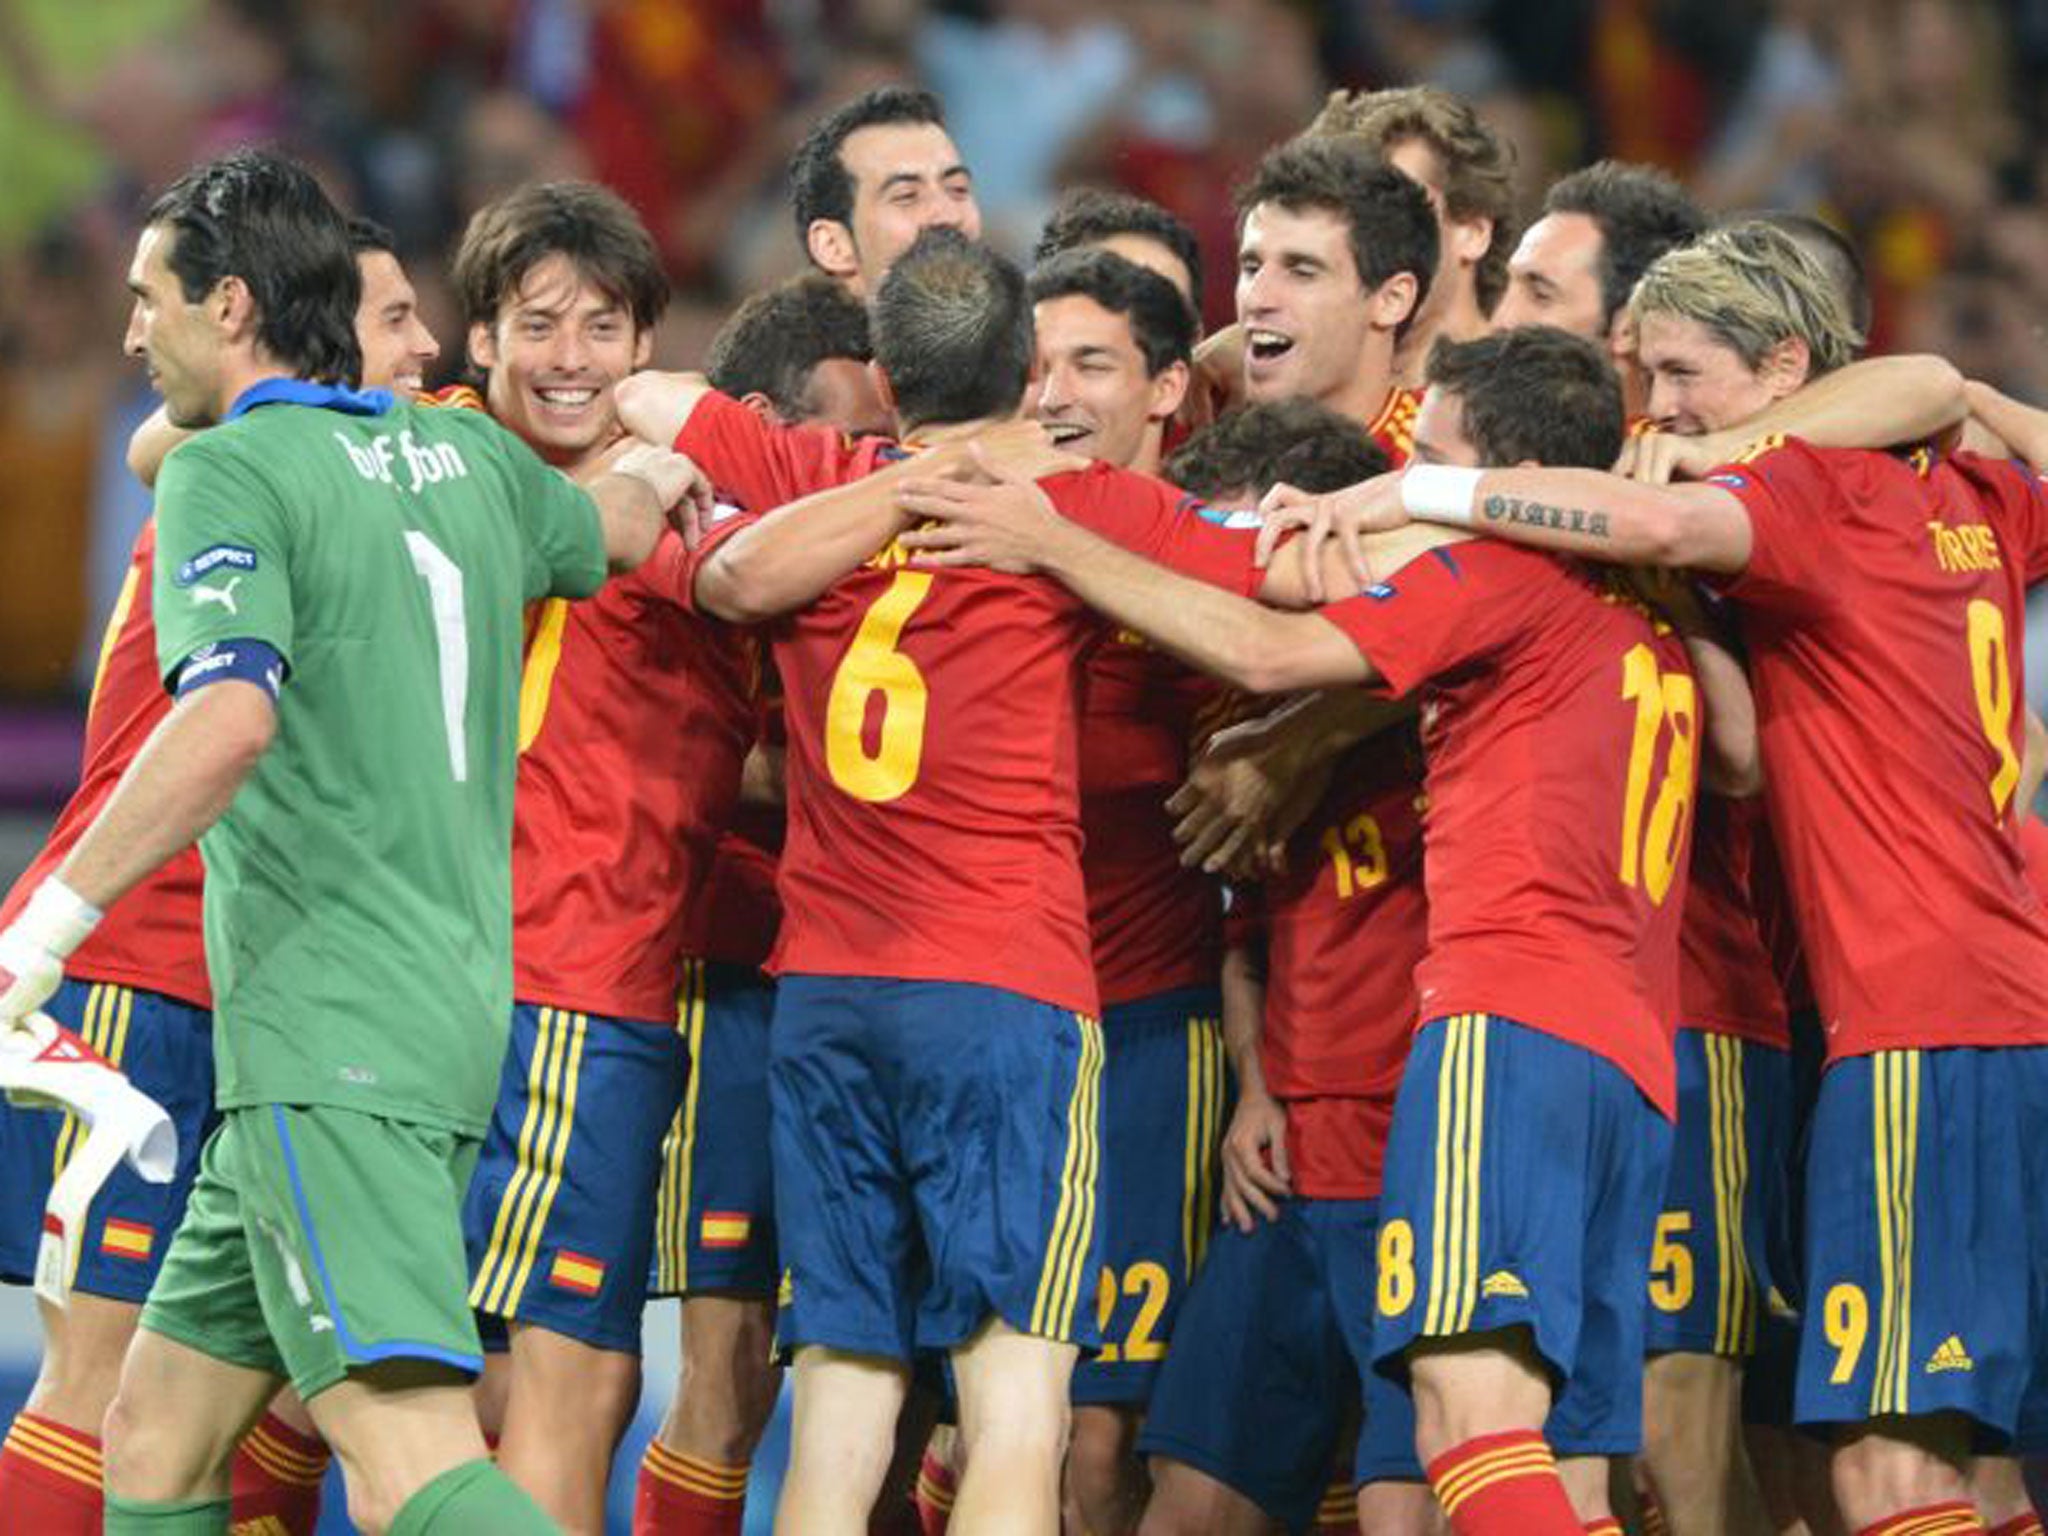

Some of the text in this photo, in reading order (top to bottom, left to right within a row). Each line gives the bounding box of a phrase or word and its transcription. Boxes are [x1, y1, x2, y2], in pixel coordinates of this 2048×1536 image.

[403, 530, 469, 781] 1
[825, 571, 934, 803] 6
[1966, 599, 2021, 830] 9
[1323, 815, 1387, 898] 13
[1620, 642, 1696, 907] 18
[1377, 1219, 1415, 1317] 8
[1648, 1211, 1694, 1312] 5
[1824, 1283, 1868, 1384] 9
